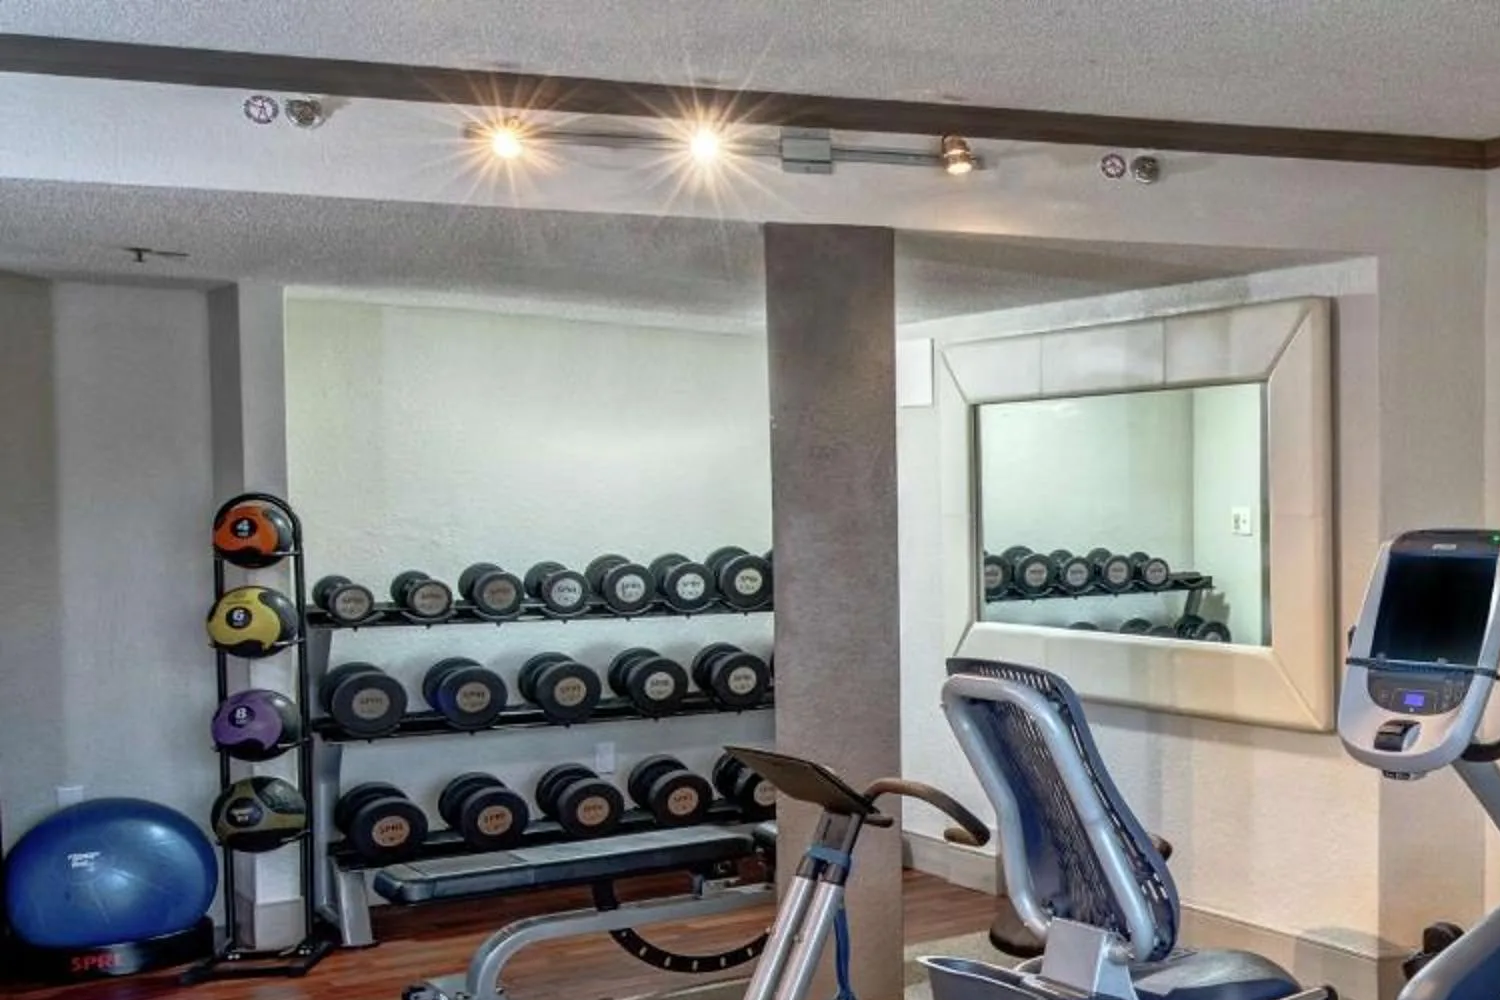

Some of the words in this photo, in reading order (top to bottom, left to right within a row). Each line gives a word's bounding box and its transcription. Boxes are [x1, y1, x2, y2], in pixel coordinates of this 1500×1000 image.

[236, 519, 249, 532] 4
[232, 609, 245, 621] 6
[236, 707, 247, 719] 8
